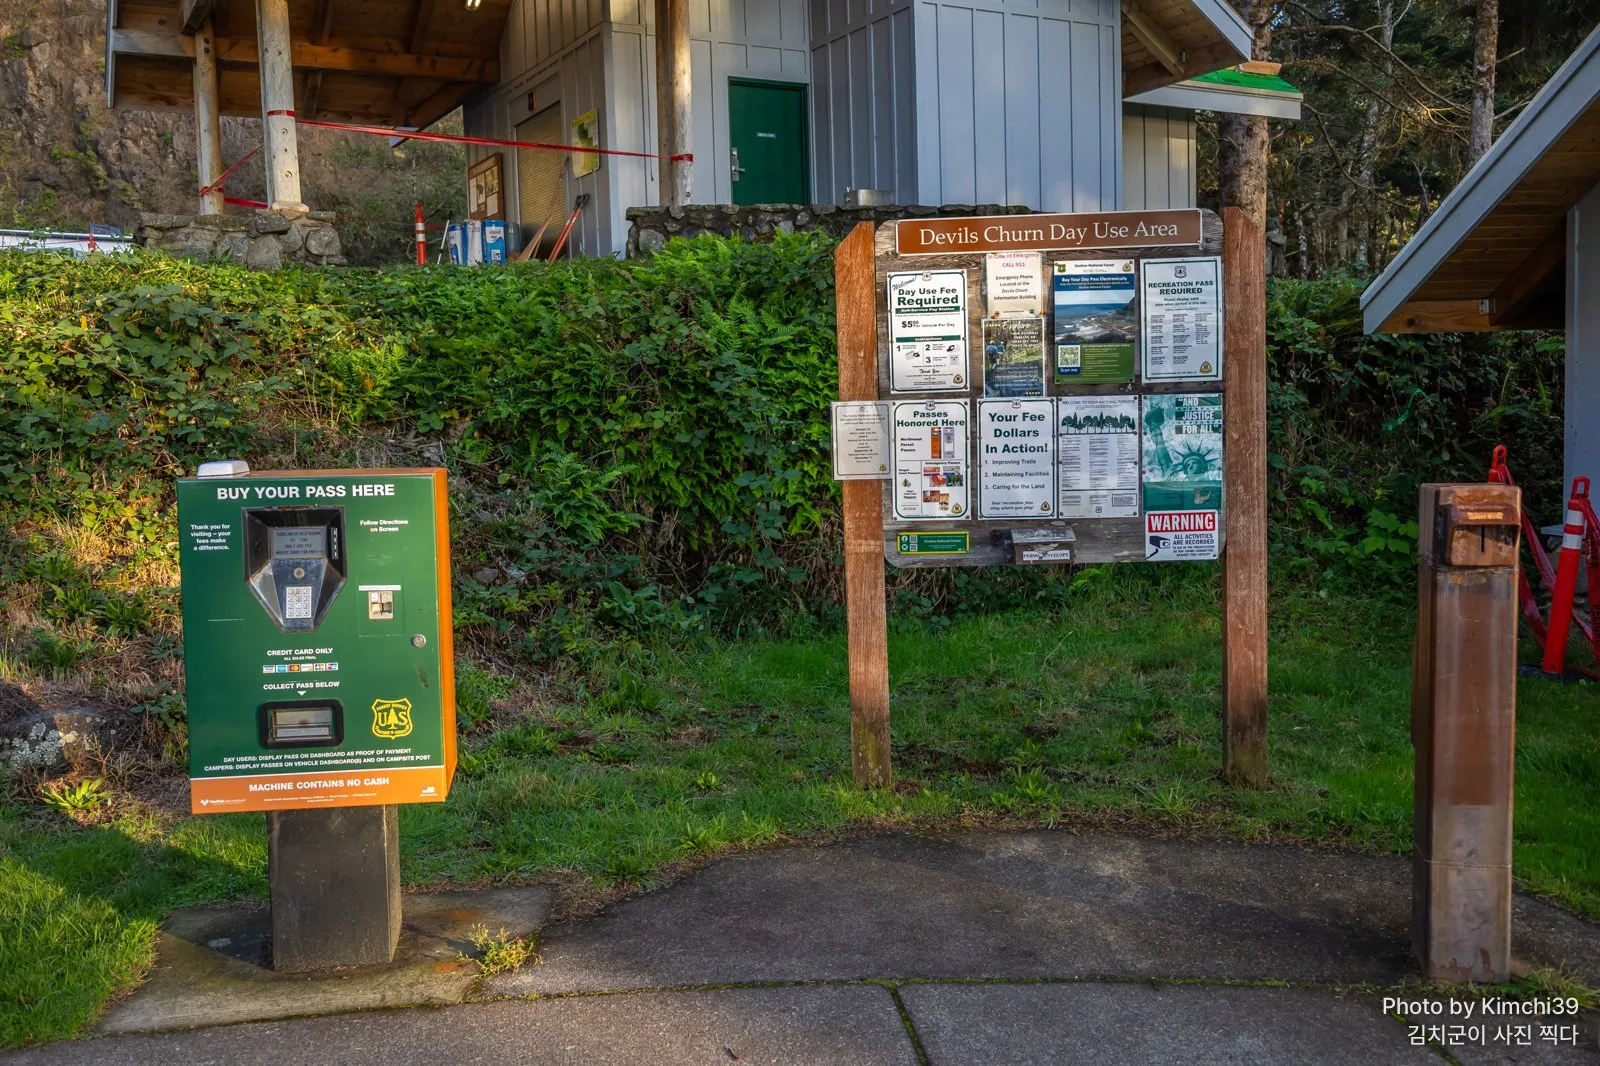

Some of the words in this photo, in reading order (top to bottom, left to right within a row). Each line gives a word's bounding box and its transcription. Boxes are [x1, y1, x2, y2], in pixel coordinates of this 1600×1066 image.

[919, 227, 978, 246] Devils
[984, 226, 1044, 242] Churn
[1050, 224, 1087, 246] Day
[1094, 222, 1128, 239] Use
[1134, 221, 1178, 237] Area
[892, 275, 918, 291] Welcome!
[898, 295, 958, 307] Required
[1002, 320, 1031, 331] Explore
[988, 412, 1018, 422] Your
[1022, 412, 1045, 421] Fee
[1182, 411, 1214, 420] JUSTICE
[994, 428, 1039, 438] Dollars
[1183, 425, 1198, 434] FOR
[986, 444, 997, 454] In
[1002, 443, 1048, 453] Action!
[217, 487, 250, 500] BUY
[254, 486, 300, 499] YOUR
[306, 485, 346, 498] PASS
[352, 484, 395, 497] HERE
[1150, 514, 1213, 531] WARNING
[249, 782, 294, 792] MACHINE
[296, 780, 344, 789] CONTAINS
[364, 777, 390, 786] CASH
